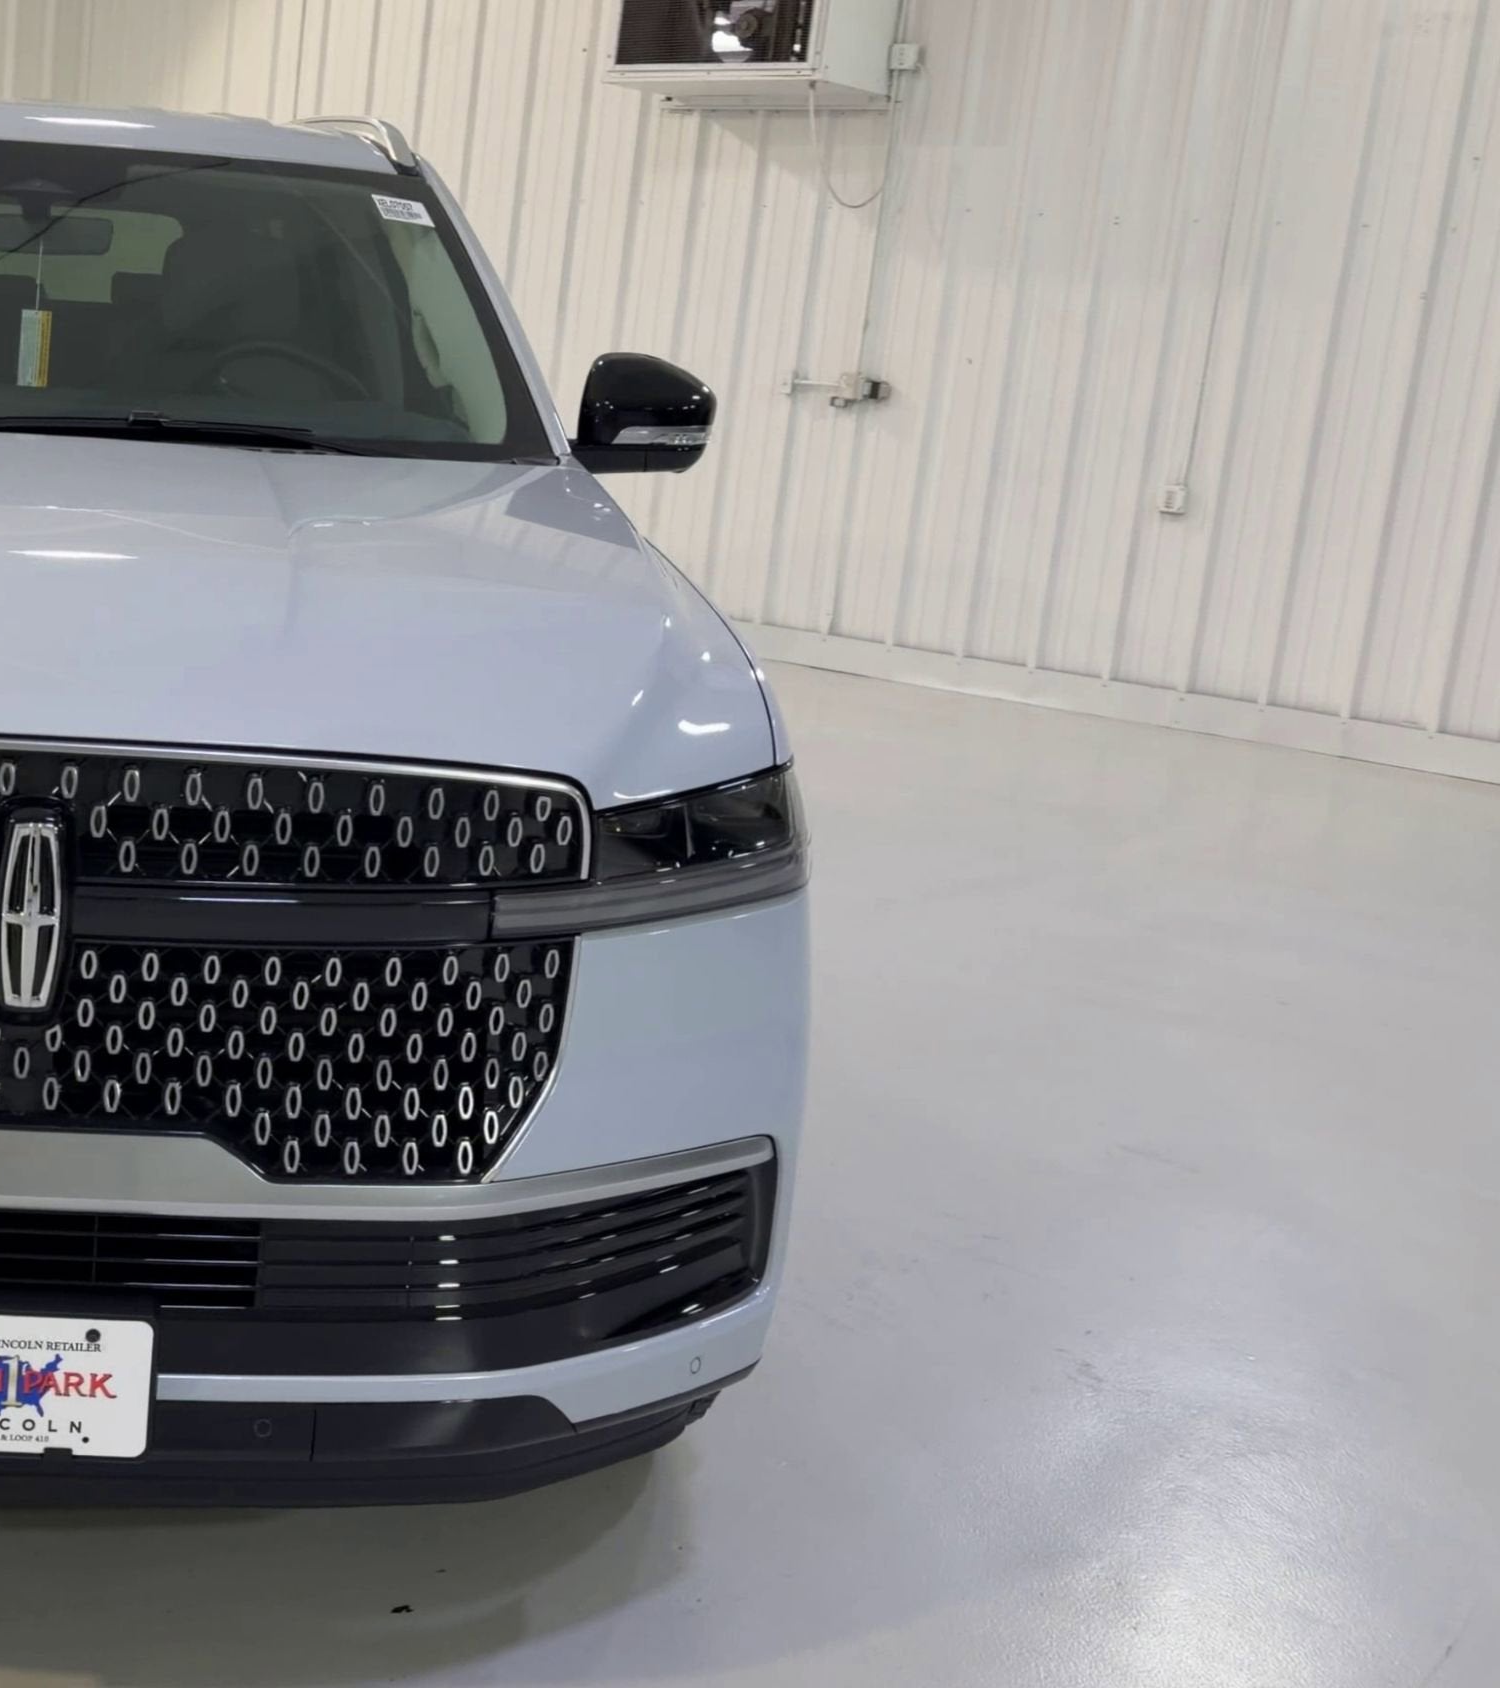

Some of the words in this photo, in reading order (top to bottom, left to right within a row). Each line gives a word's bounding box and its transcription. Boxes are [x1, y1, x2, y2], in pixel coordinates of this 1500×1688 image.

[46, 1341, 102, 1353] RETAILER
[23, 1370, 118, 1399] PARK
[9, 1434, 33, 1442] LOOP
